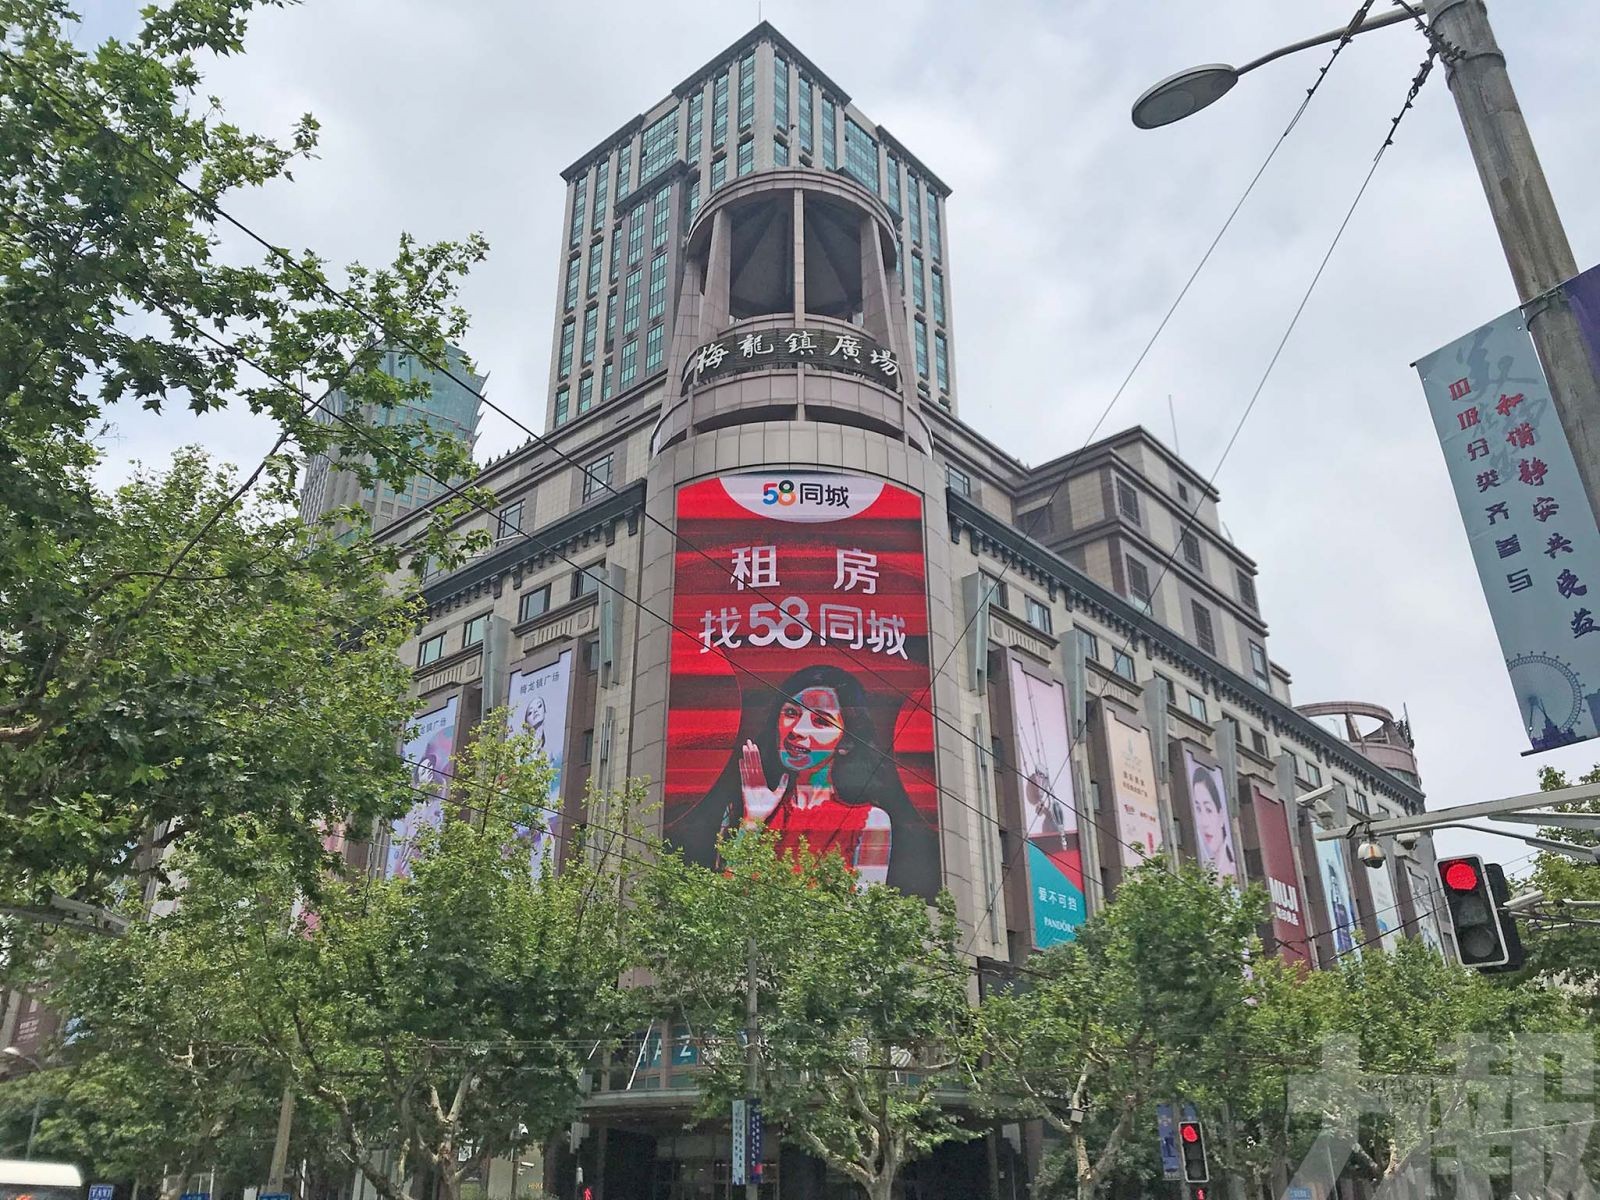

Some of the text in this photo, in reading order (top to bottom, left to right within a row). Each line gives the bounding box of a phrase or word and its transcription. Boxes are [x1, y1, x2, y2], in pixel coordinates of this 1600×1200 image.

[697, 330, 900, 377] 梅龍鎮廣場
[762, 479, 850, 509] 58同城
[698, 596, 909, 660] 找58同城
